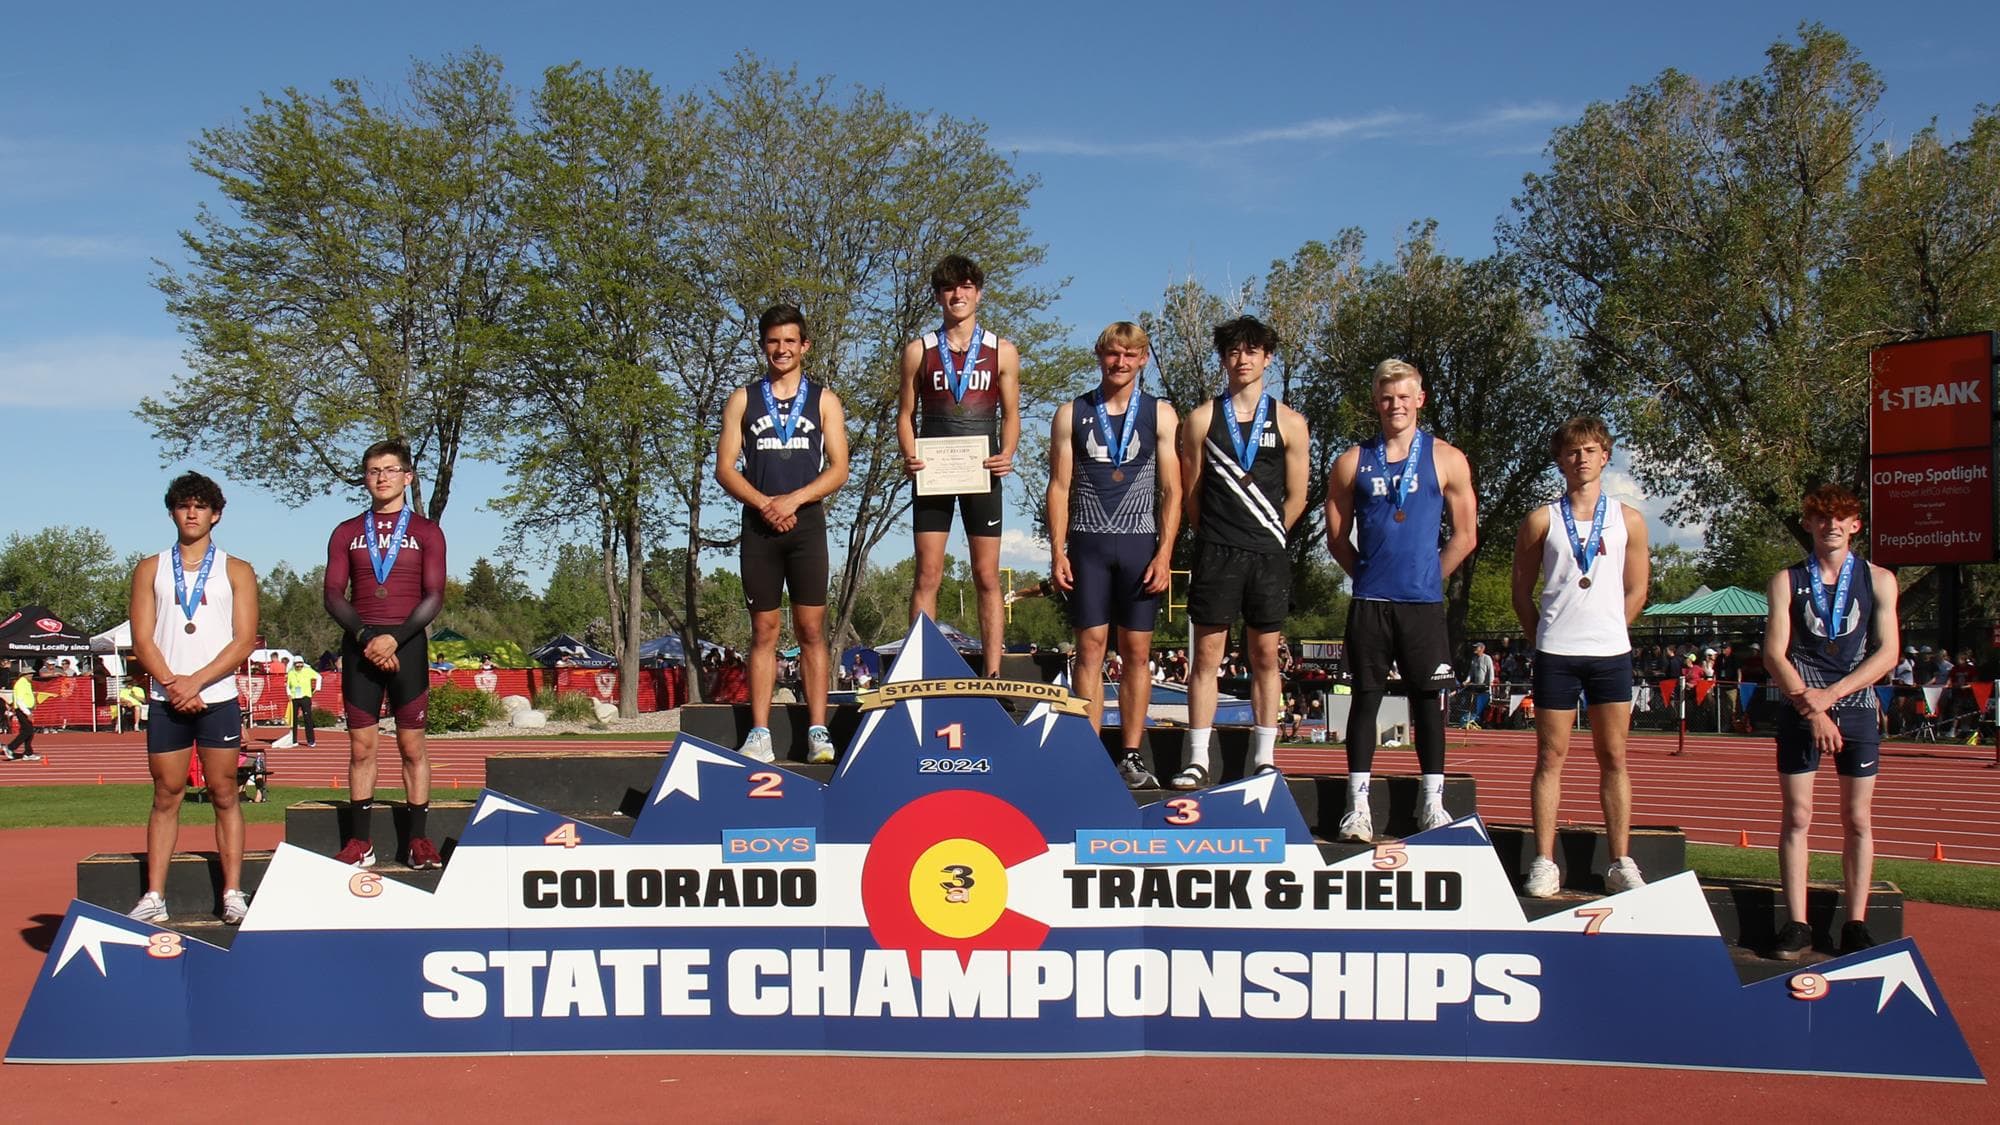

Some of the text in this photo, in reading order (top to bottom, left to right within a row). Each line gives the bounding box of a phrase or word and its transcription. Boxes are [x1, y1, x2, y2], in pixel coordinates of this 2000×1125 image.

[933, 370, 991, 391] EON
[1878, 379, 1982, 412] 1STBANK
[1873, 464, 1988, 486] CO Prep Spotlight
[350, 533, 420, 550] ALMSA
[1879, 529, 1982, 549] PrepSpotlight.tv
[8, 643, 40, 651] Running
[42, 643, 69, 651] Locally
[885, 681, 1061, 698] STATE CHAMPION
[935, 721, 964, 750] 1
[919, 758, 991, 773] 2024
[746, 771, 785, 799] 2
[1164, 798, 1202, 826] 3
[543, 823, 581, 848] 4
[729, 836, 810, 855] BOYS
[1089, 837, 1273, 855] POLE VAULT
[1371, 842, 1409, 870] 5
[348, 871, 384, 898] 6
[522, 868, 1463, 912] COLORADO TRACK & FIELD
[939, 865, 975, 890] 3
[1574, 907, 1613, 936] 7
[146, 931, 184, 959] 8
[422, 948, 1543, 1024] STATE CHAMPIONSHIPS
[1788, 972, 1830, 1001] 9
